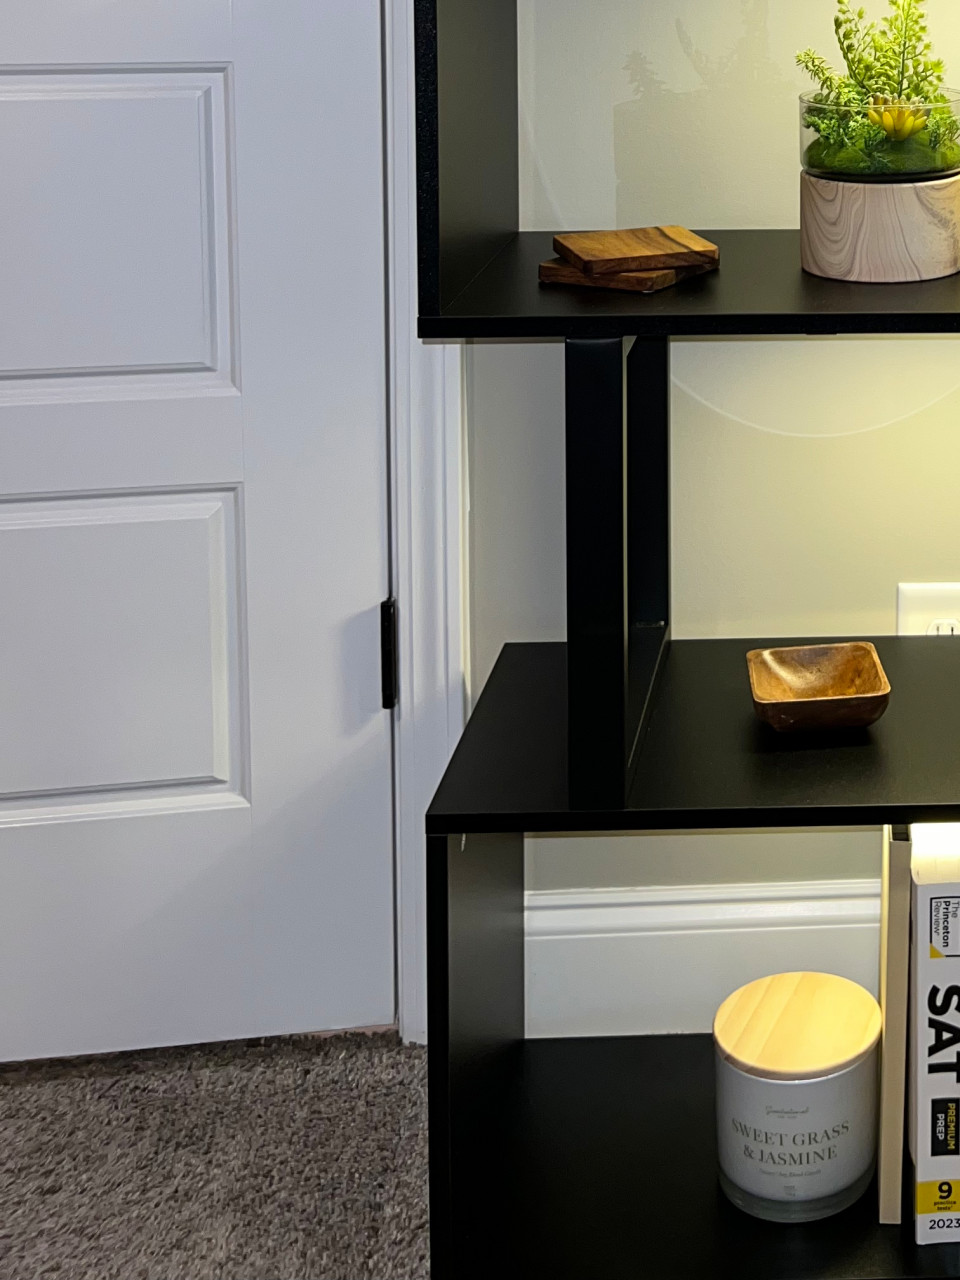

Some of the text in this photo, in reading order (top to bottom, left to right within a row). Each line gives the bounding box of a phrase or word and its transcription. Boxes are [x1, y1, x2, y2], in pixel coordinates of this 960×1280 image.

[933, 900, 942, 935] Review
[951, 900, 960, 919] The
[942, 900, 951, 948] Princeton
[732, 1117, 850, 1147] SWEET GRASS
[936, 1113, 945, 1141] PREP
[947, 1103, 956, 1150] PREMIUM
[743, 1144, 838, 1166] & JASMINE
[937, 1181, 953, 1200] 9
[928, 1218, 960, 1230] 2023
